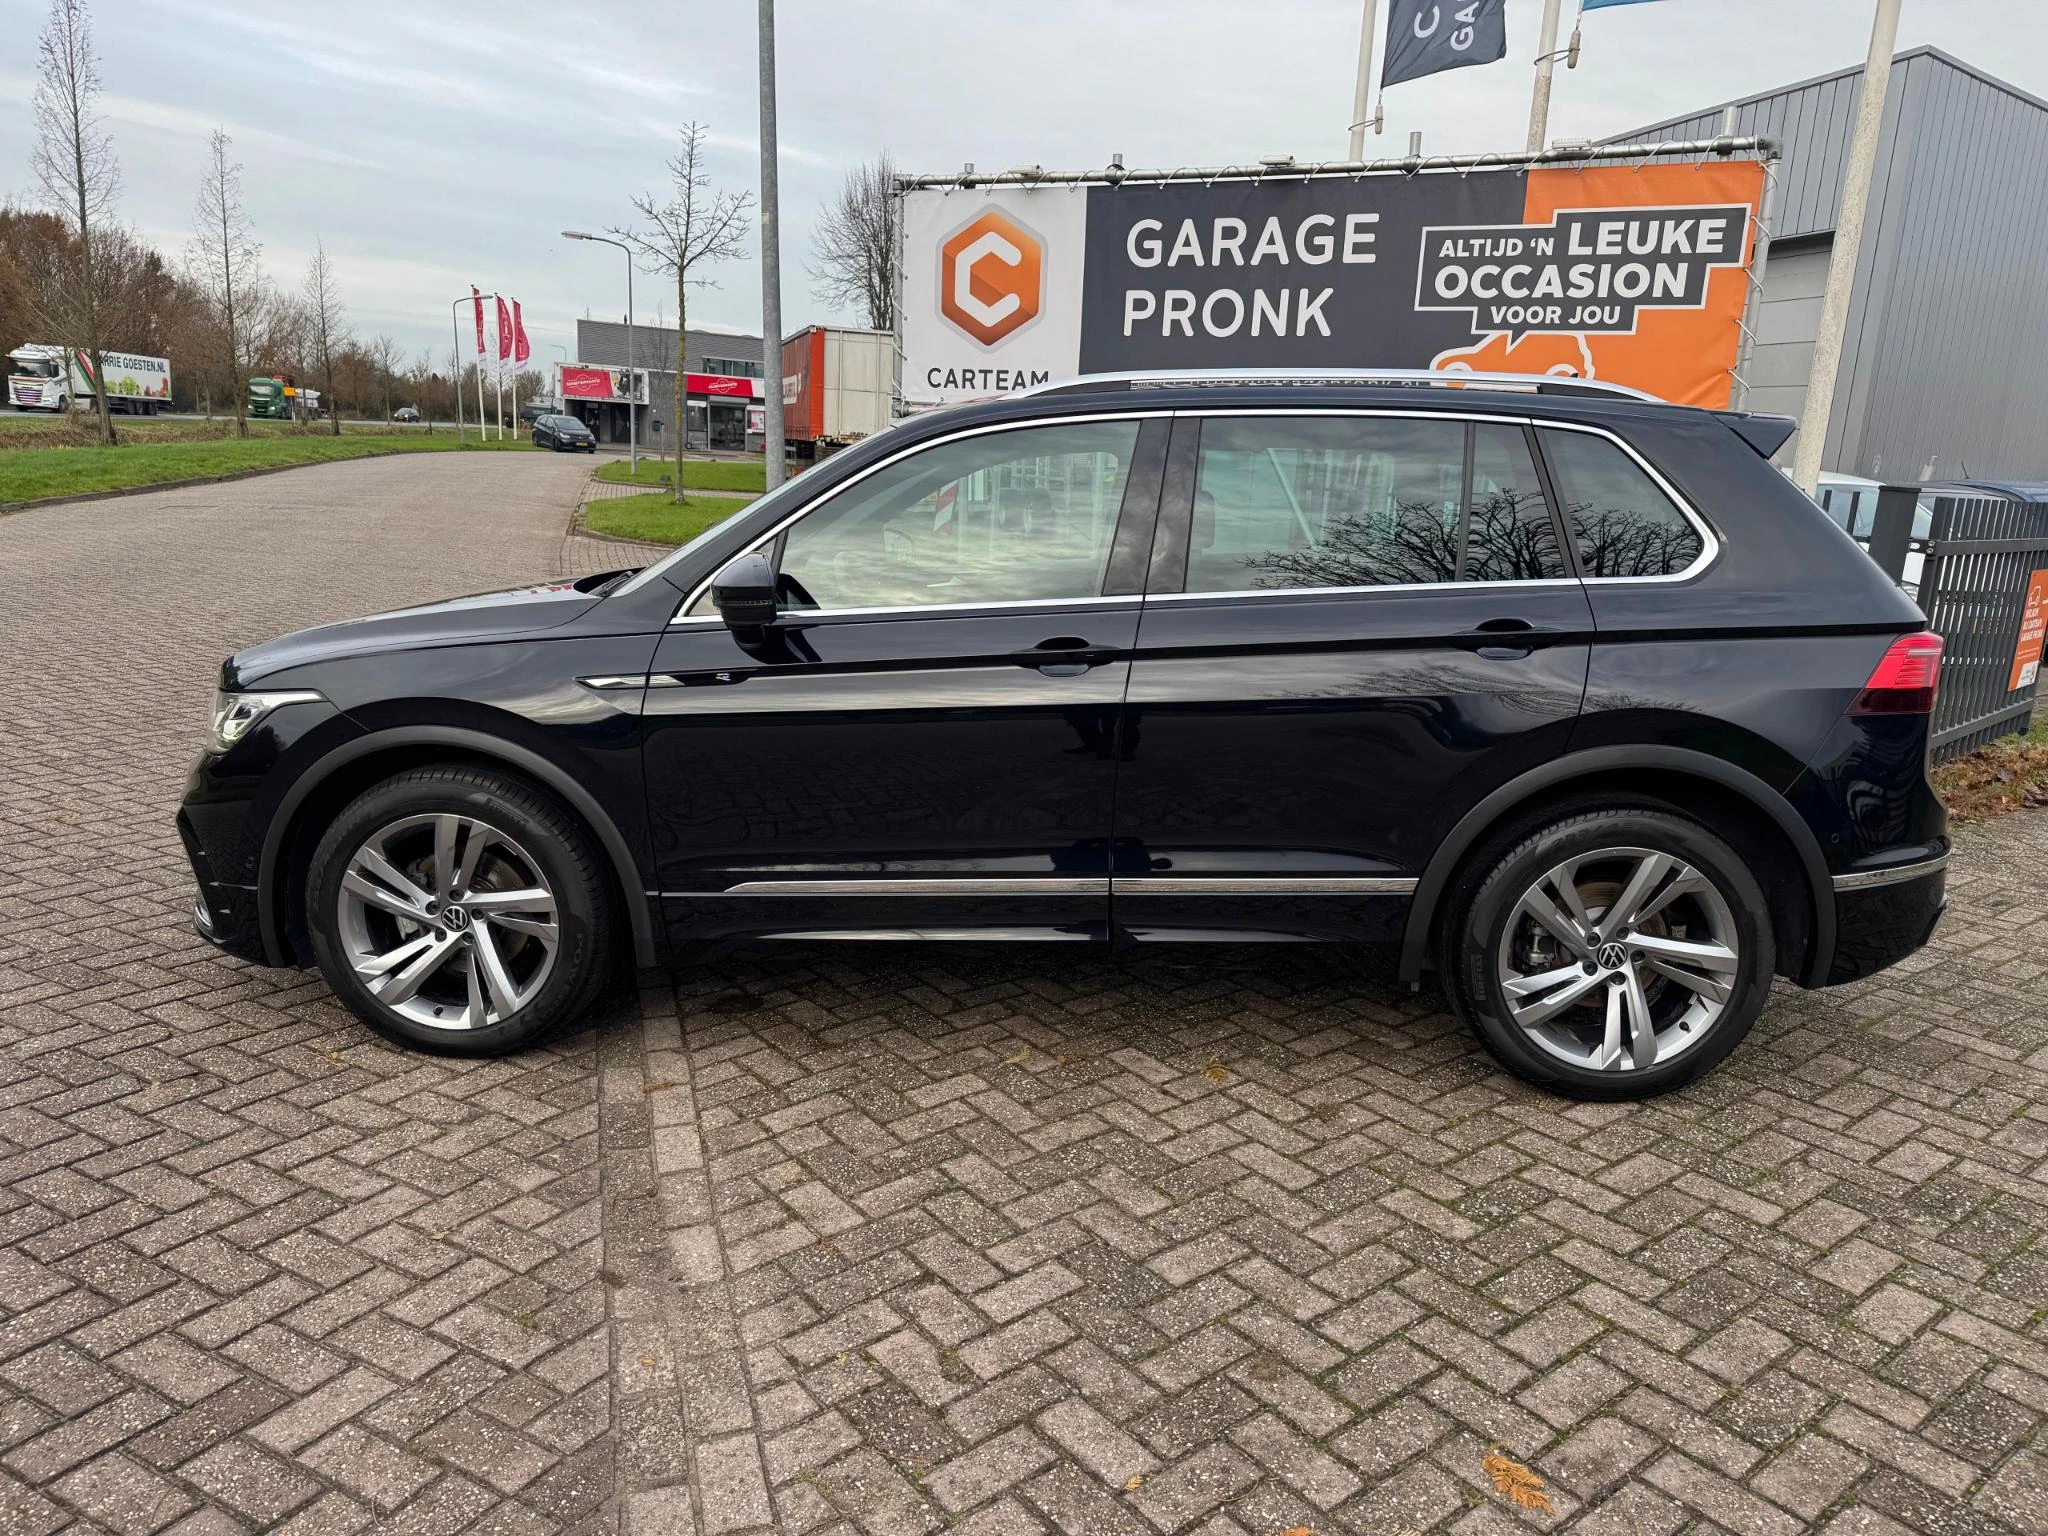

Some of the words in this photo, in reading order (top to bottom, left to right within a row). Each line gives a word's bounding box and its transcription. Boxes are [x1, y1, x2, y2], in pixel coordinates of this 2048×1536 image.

[1126, 212, 1380, 269] GARAGE
[1438, 237, 1524, 258] ALTIJD
[1567, 217, 1728, 256] LEUKE
[1434, 262, 1689, 299] OCCASION
[1122, 287, 1334, 339] PRONK
[1490, 305, 1561, 325] VOOR
[1567, 304, 1622, 325] JOU
[927, 367, 1050, 391] CARTEAM
